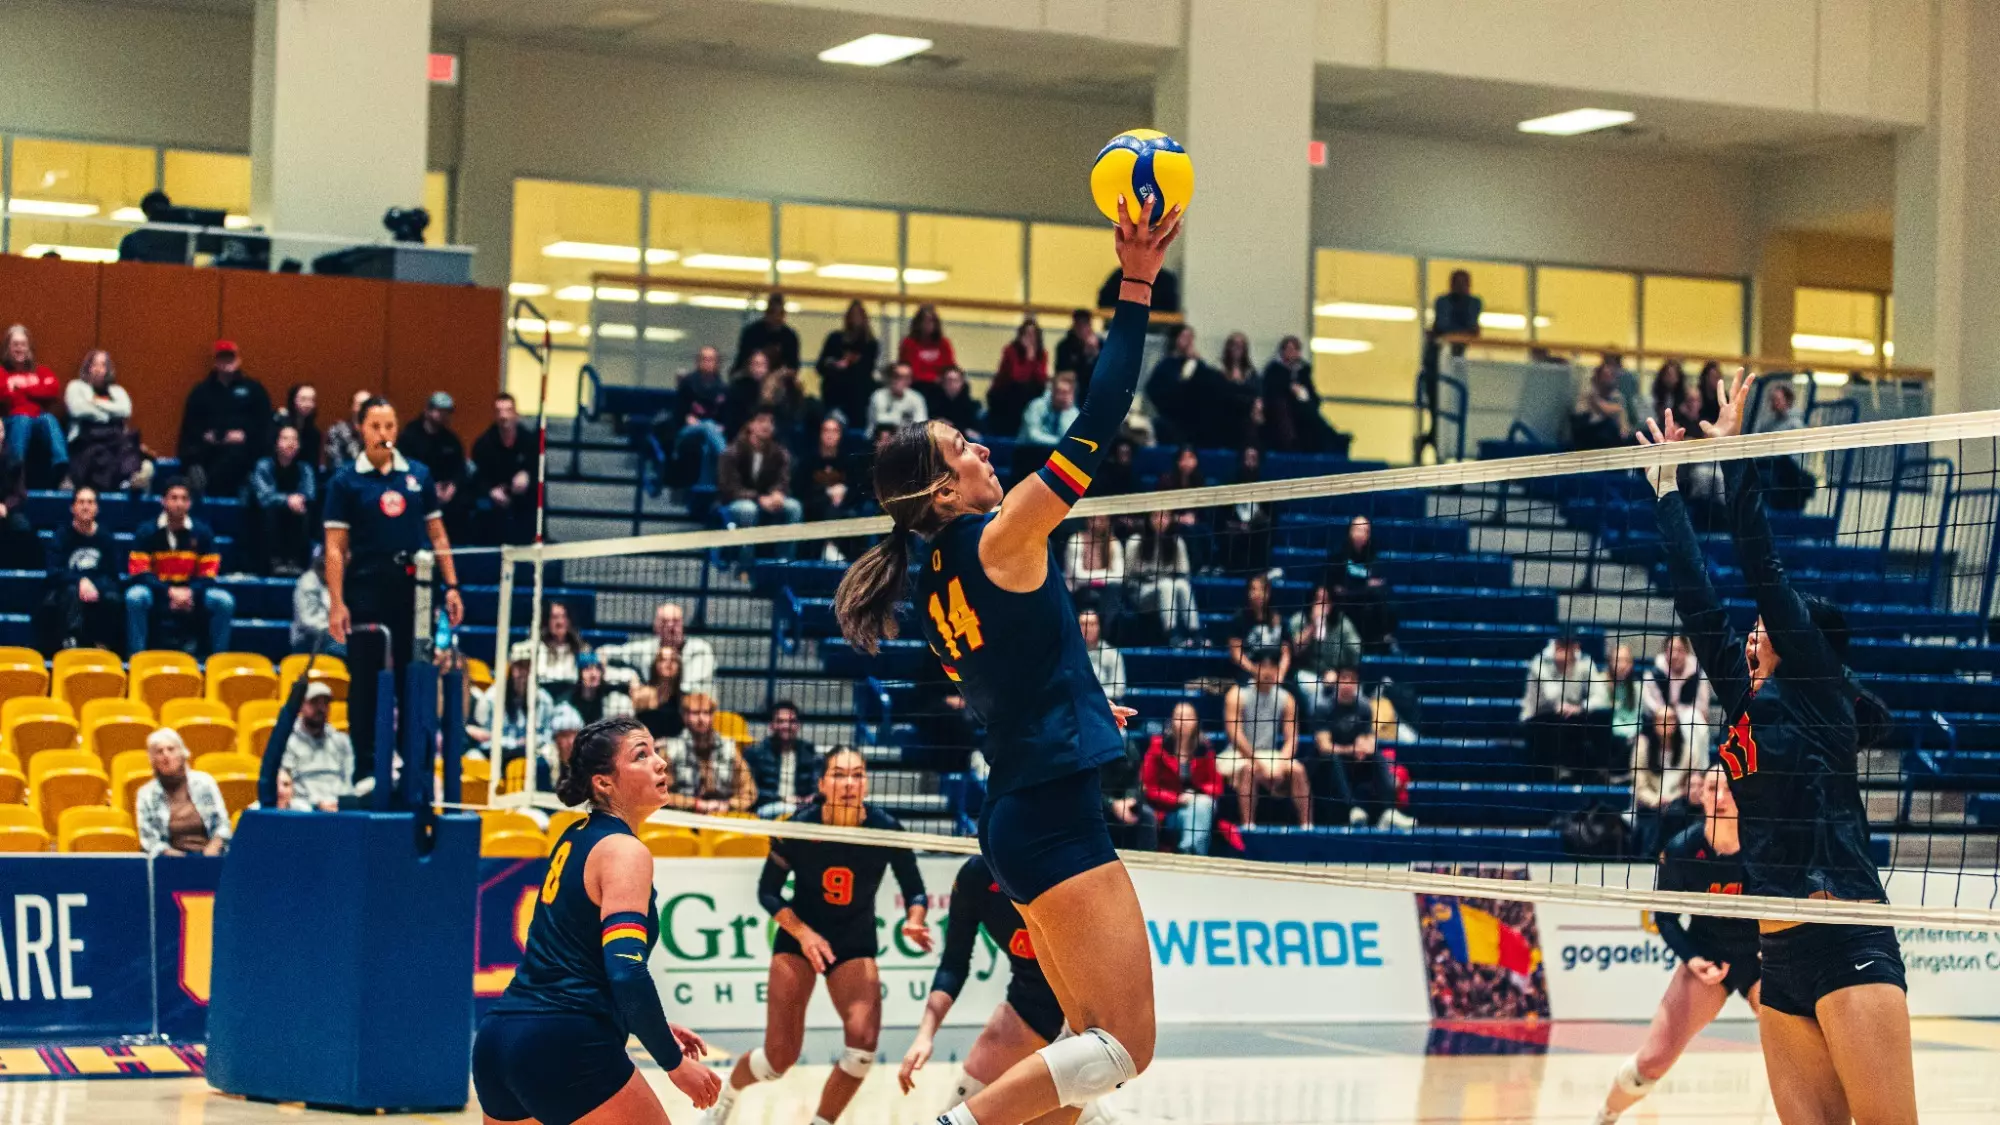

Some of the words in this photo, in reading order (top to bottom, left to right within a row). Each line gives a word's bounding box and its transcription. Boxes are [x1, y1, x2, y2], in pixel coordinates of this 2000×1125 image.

[928, 575, 985, 661] 14
[541, 840, 572, 905] 8
[822, 866, 854, 905] 9
[1147, 920, 1384, 967] WERADE
[1561, 938, 1677, 972] gogaelsg
